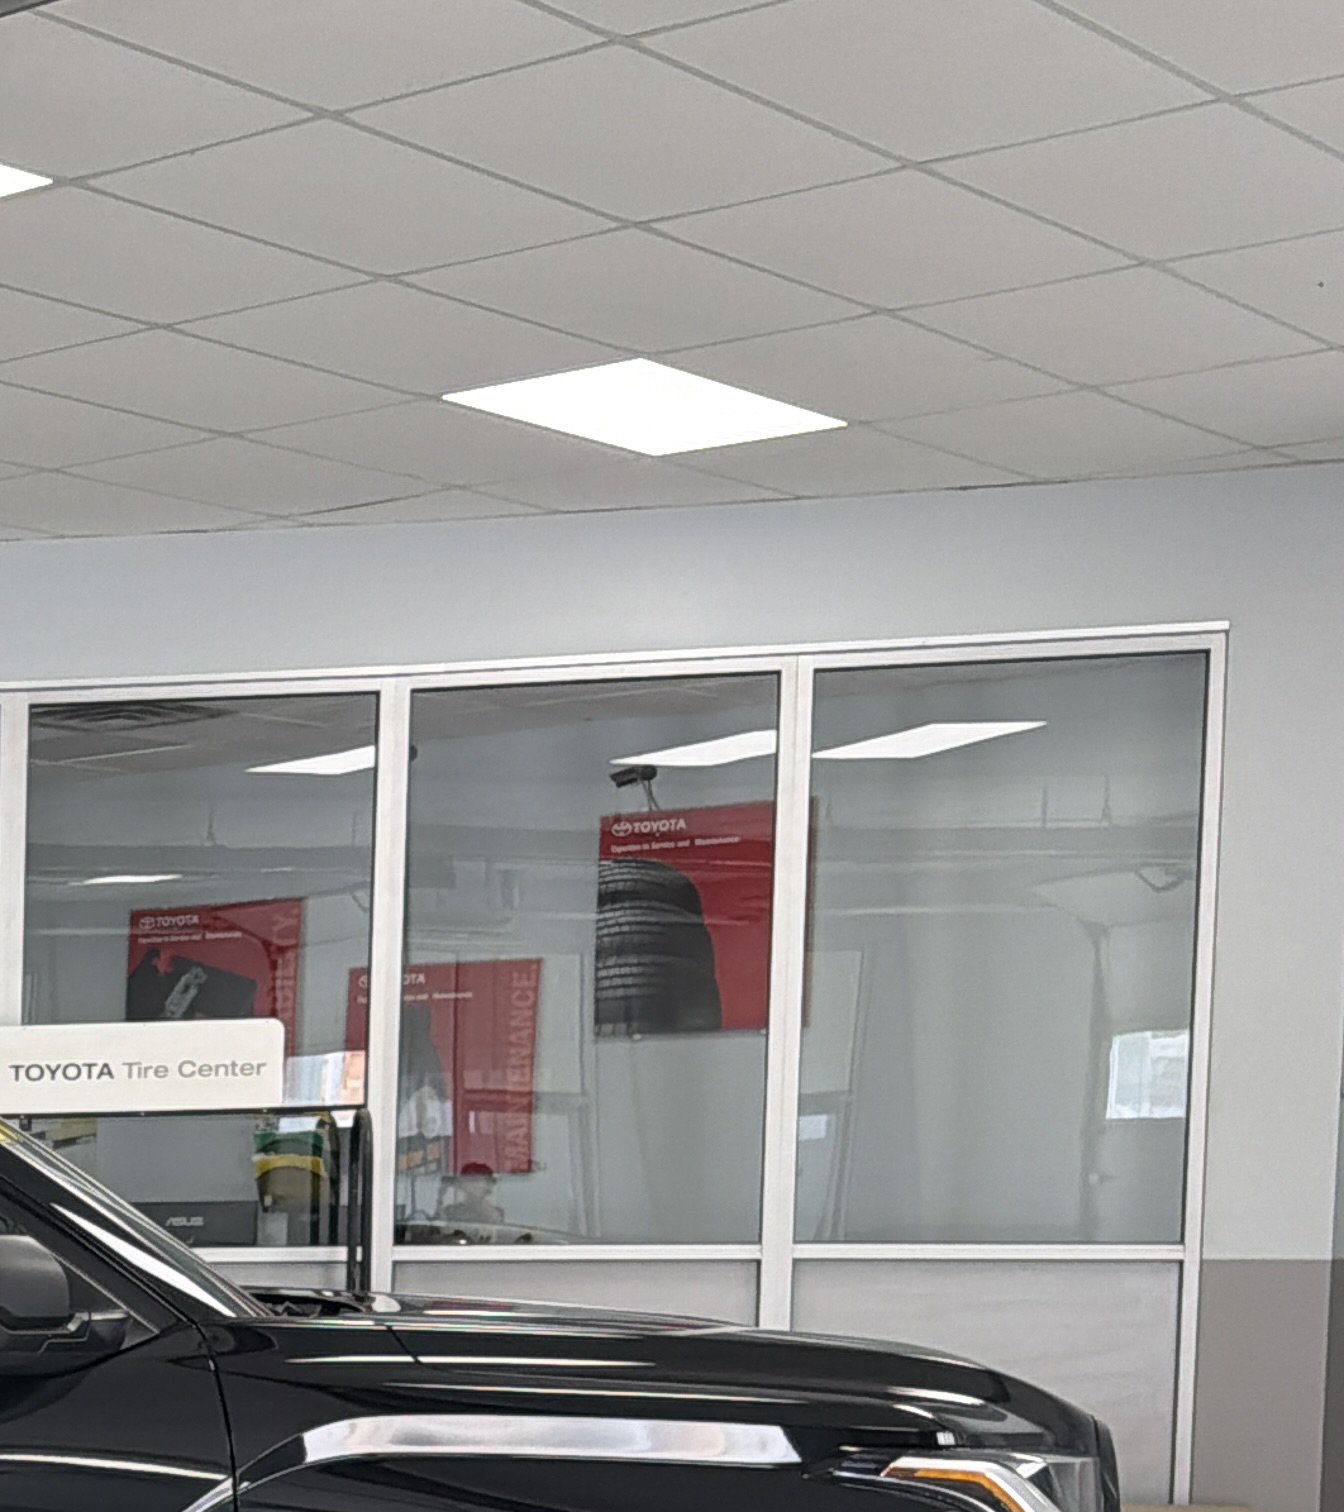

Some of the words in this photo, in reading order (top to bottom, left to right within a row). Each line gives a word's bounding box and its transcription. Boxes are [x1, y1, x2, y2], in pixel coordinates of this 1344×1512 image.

[632, 818, 687, 833] TOYOTA
[155, 914, 199, 927] TOYOTA
[403, 973, 426, 985] OTA
[9, 1062, 115, 1083] TOYOTA
[122, 1061, 169, 1079] Tire
[177, 1059, 267, 1079] Center
[165, 1216, 204, 1227] ASUS
